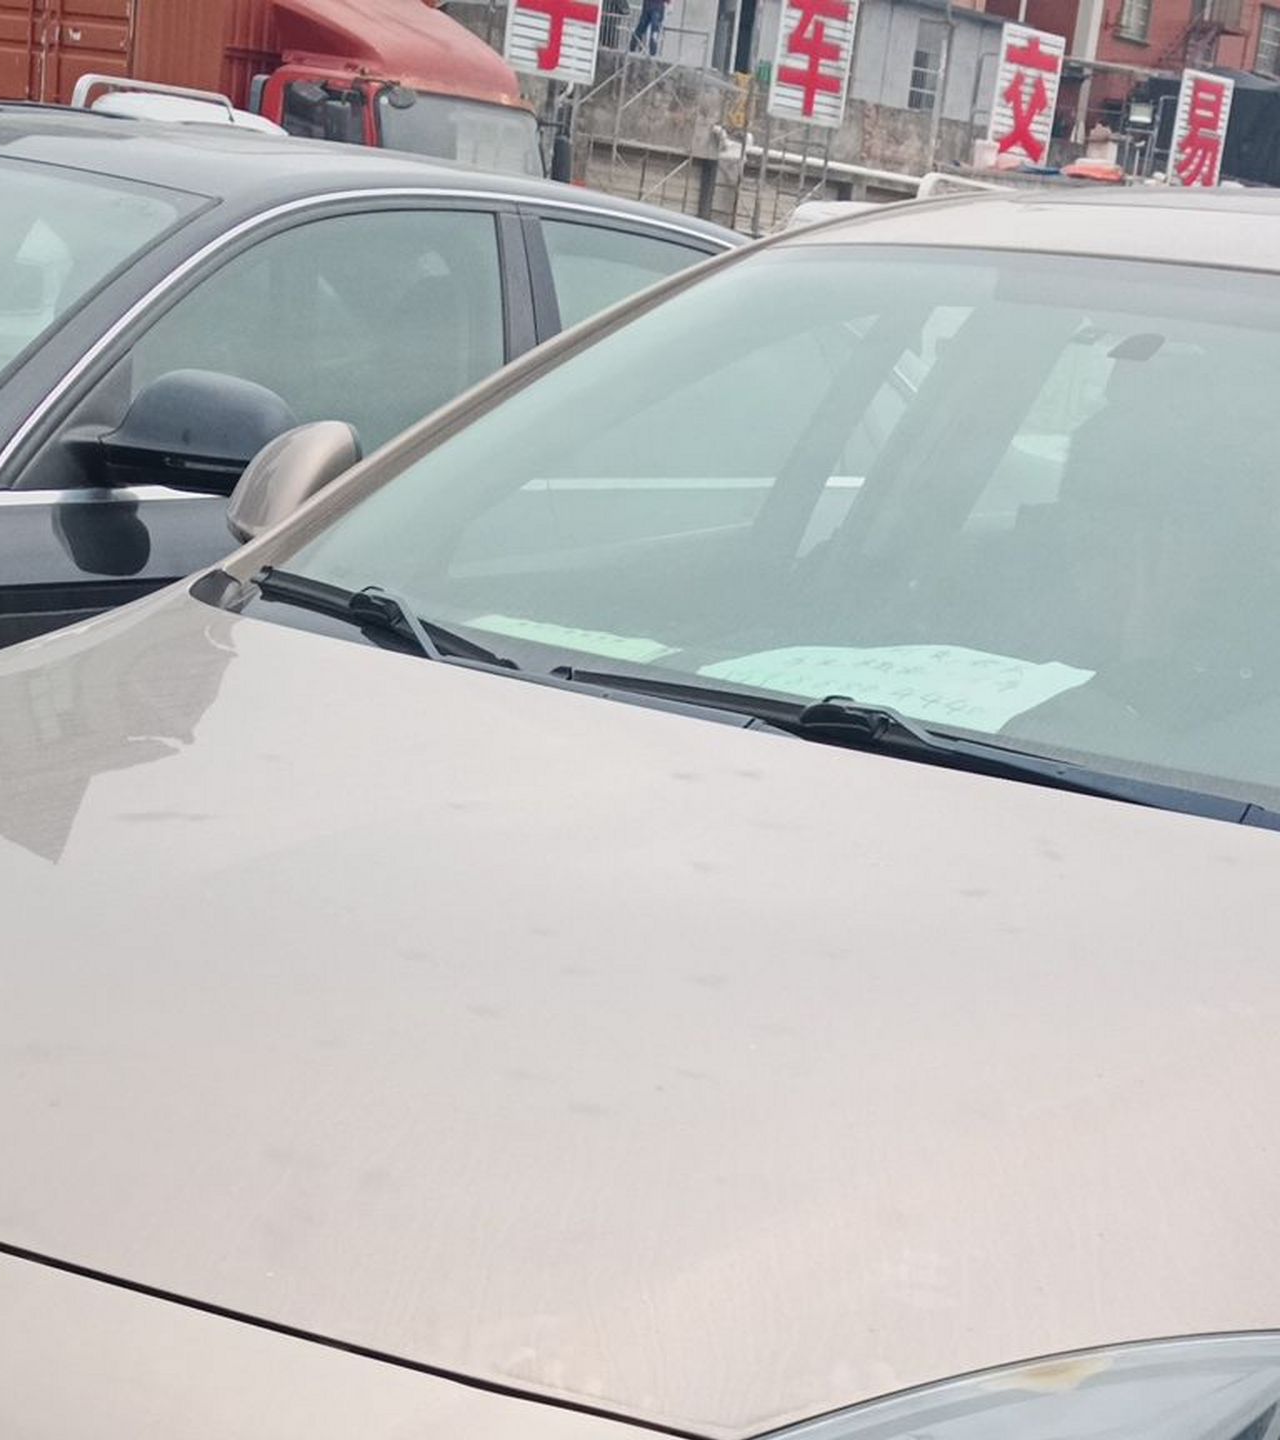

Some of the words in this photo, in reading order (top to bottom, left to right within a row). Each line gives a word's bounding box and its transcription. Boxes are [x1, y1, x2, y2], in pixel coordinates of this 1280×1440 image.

[776, 0, 850, 117] 车
[998, 34, 1060, 162] 交
[1176, 79, 1225, 188] 易
